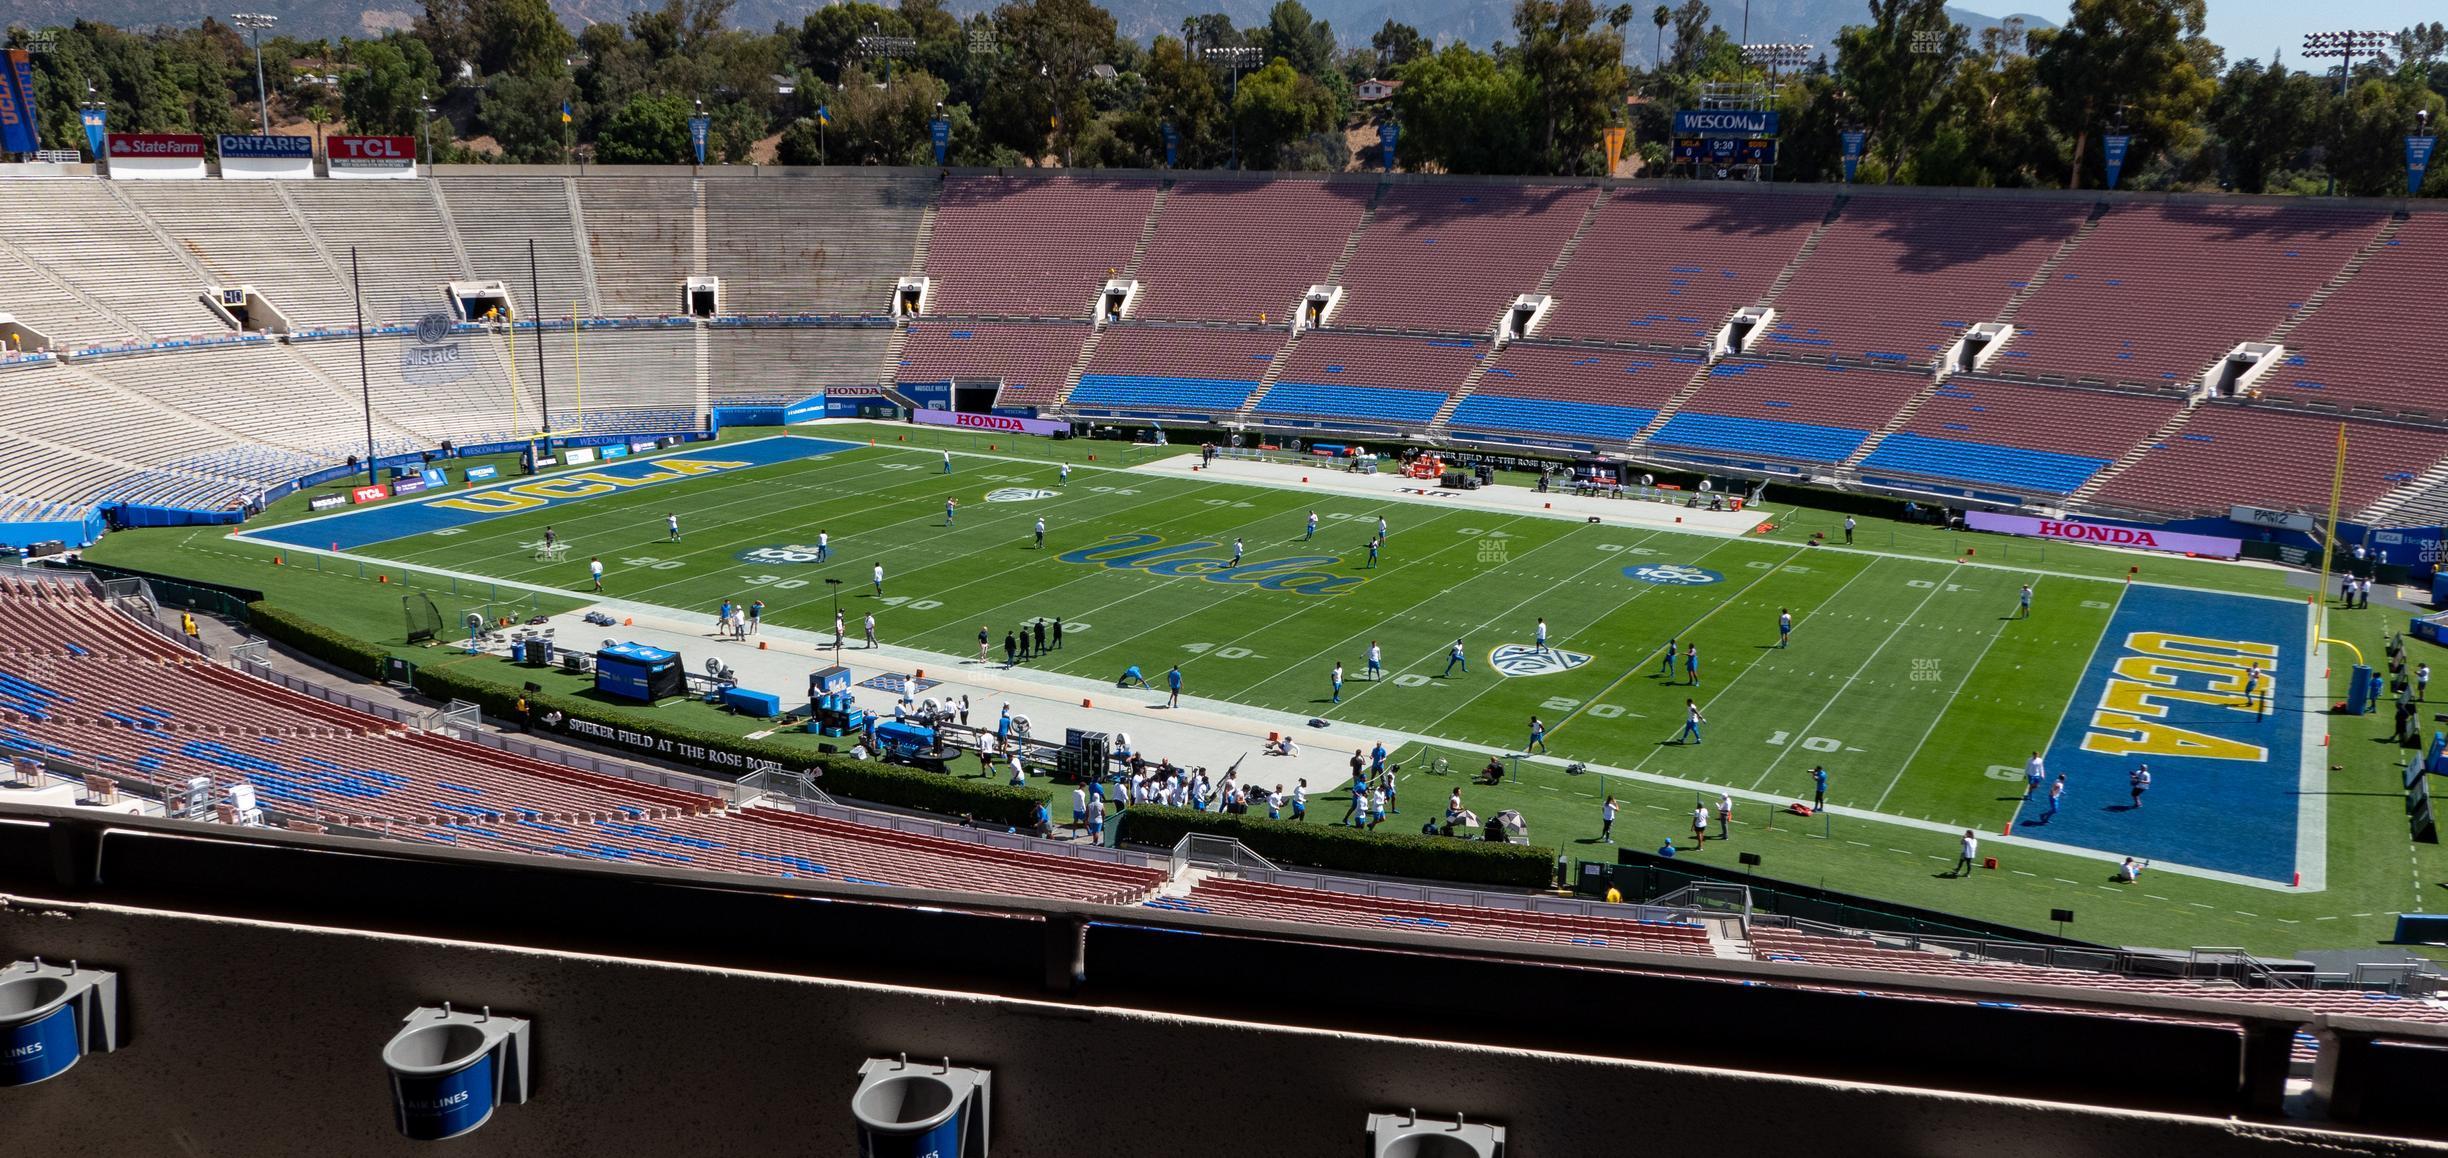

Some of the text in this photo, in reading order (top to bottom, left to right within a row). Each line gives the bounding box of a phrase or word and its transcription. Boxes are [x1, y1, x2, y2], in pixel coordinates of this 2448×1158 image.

[1684, 114, 1749, 129] WESCOM
[343, 139, 401, 157] TCL
[1713, 140, 1734, 150] 9:30
[224, 290, 242, 304] 40
[407, 346, 458, 366] Allstate
[827, 387, 880, 395] HONDA
[956, 414, 1024, 431] HONDA
[580, 436, 616, 446] WESCOM
[1458, 452, 1482, 463] FIELD
[1517, 457, 1540, 468] ROSE
[1540, 460, 1564, 470] BOWL
[358, 488, 385, 501] TCL
[422, 459, 754, 514] UCLA
[311, 495, 346, 506] NISSAN
[2038, 520, 2159, 547] HONDA
[624, 556, 687, 571] 20
[745, 574, 810, 590] 30
[1635, 567, 1715, 583] 100
[880, 595, 944, 611] 40
[1181, 641, 1254, 660] 40
[1350, 666, 1432, 688] 30
[2080, 631, 2280, 763] UCLA
[1538, 695, 1627, 719] 20
[569, 717, 784, 774] SPIEKER FIELD AT THE ROSE BOWL
[1765, 730, 1843, 753] 10
[432, 1090, 469, 1109] LINES
